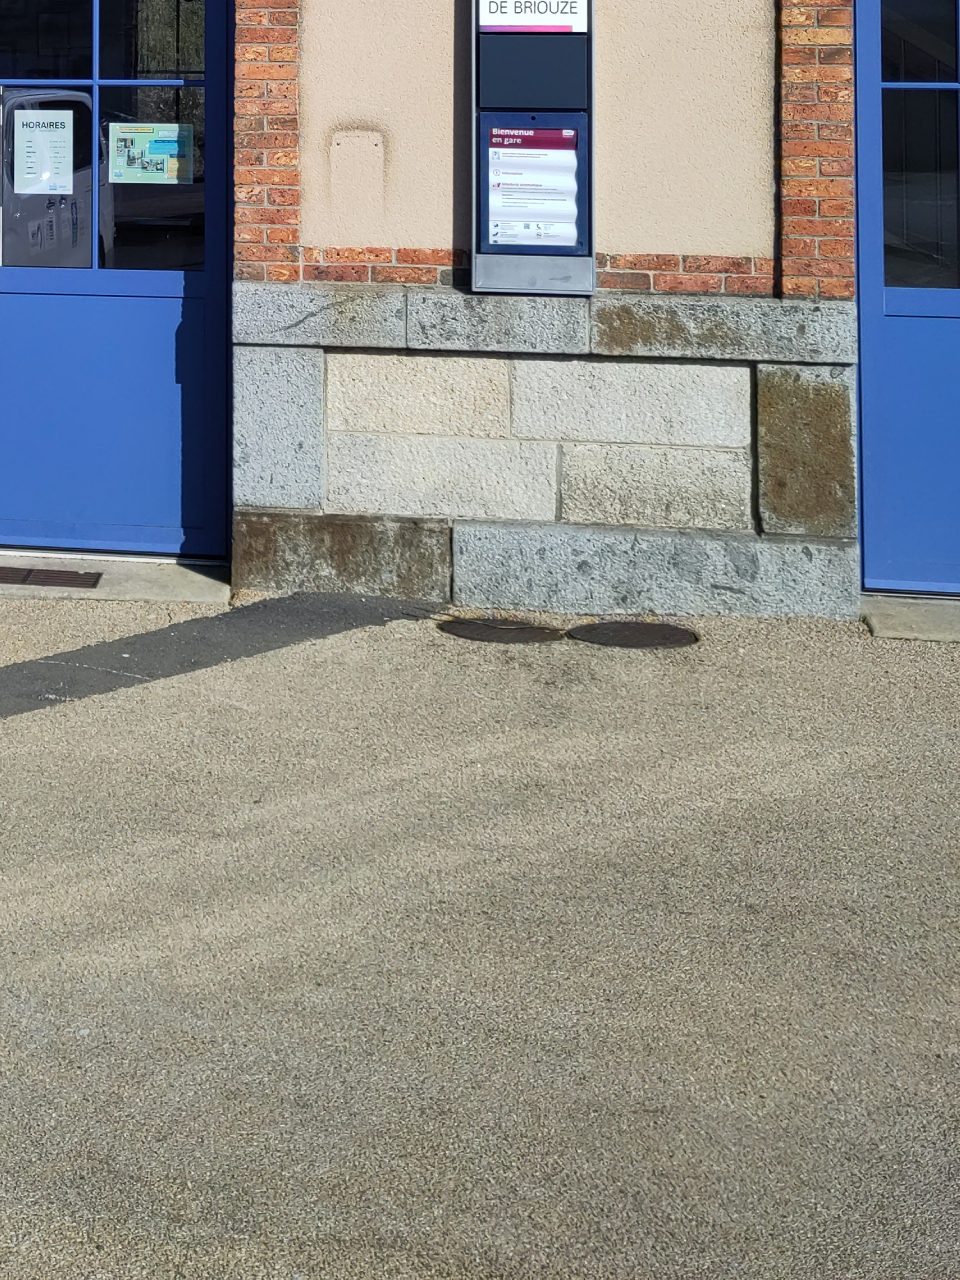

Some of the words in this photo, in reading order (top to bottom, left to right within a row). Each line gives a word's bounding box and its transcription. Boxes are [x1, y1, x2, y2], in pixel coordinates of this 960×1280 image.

[488, 0, 508, 15] DE
[513, 0, 579, 15] BRIOUZE
[21, 121, 66, 130] HORAIRES
[492, 128, 535, 136] Bienvenue
